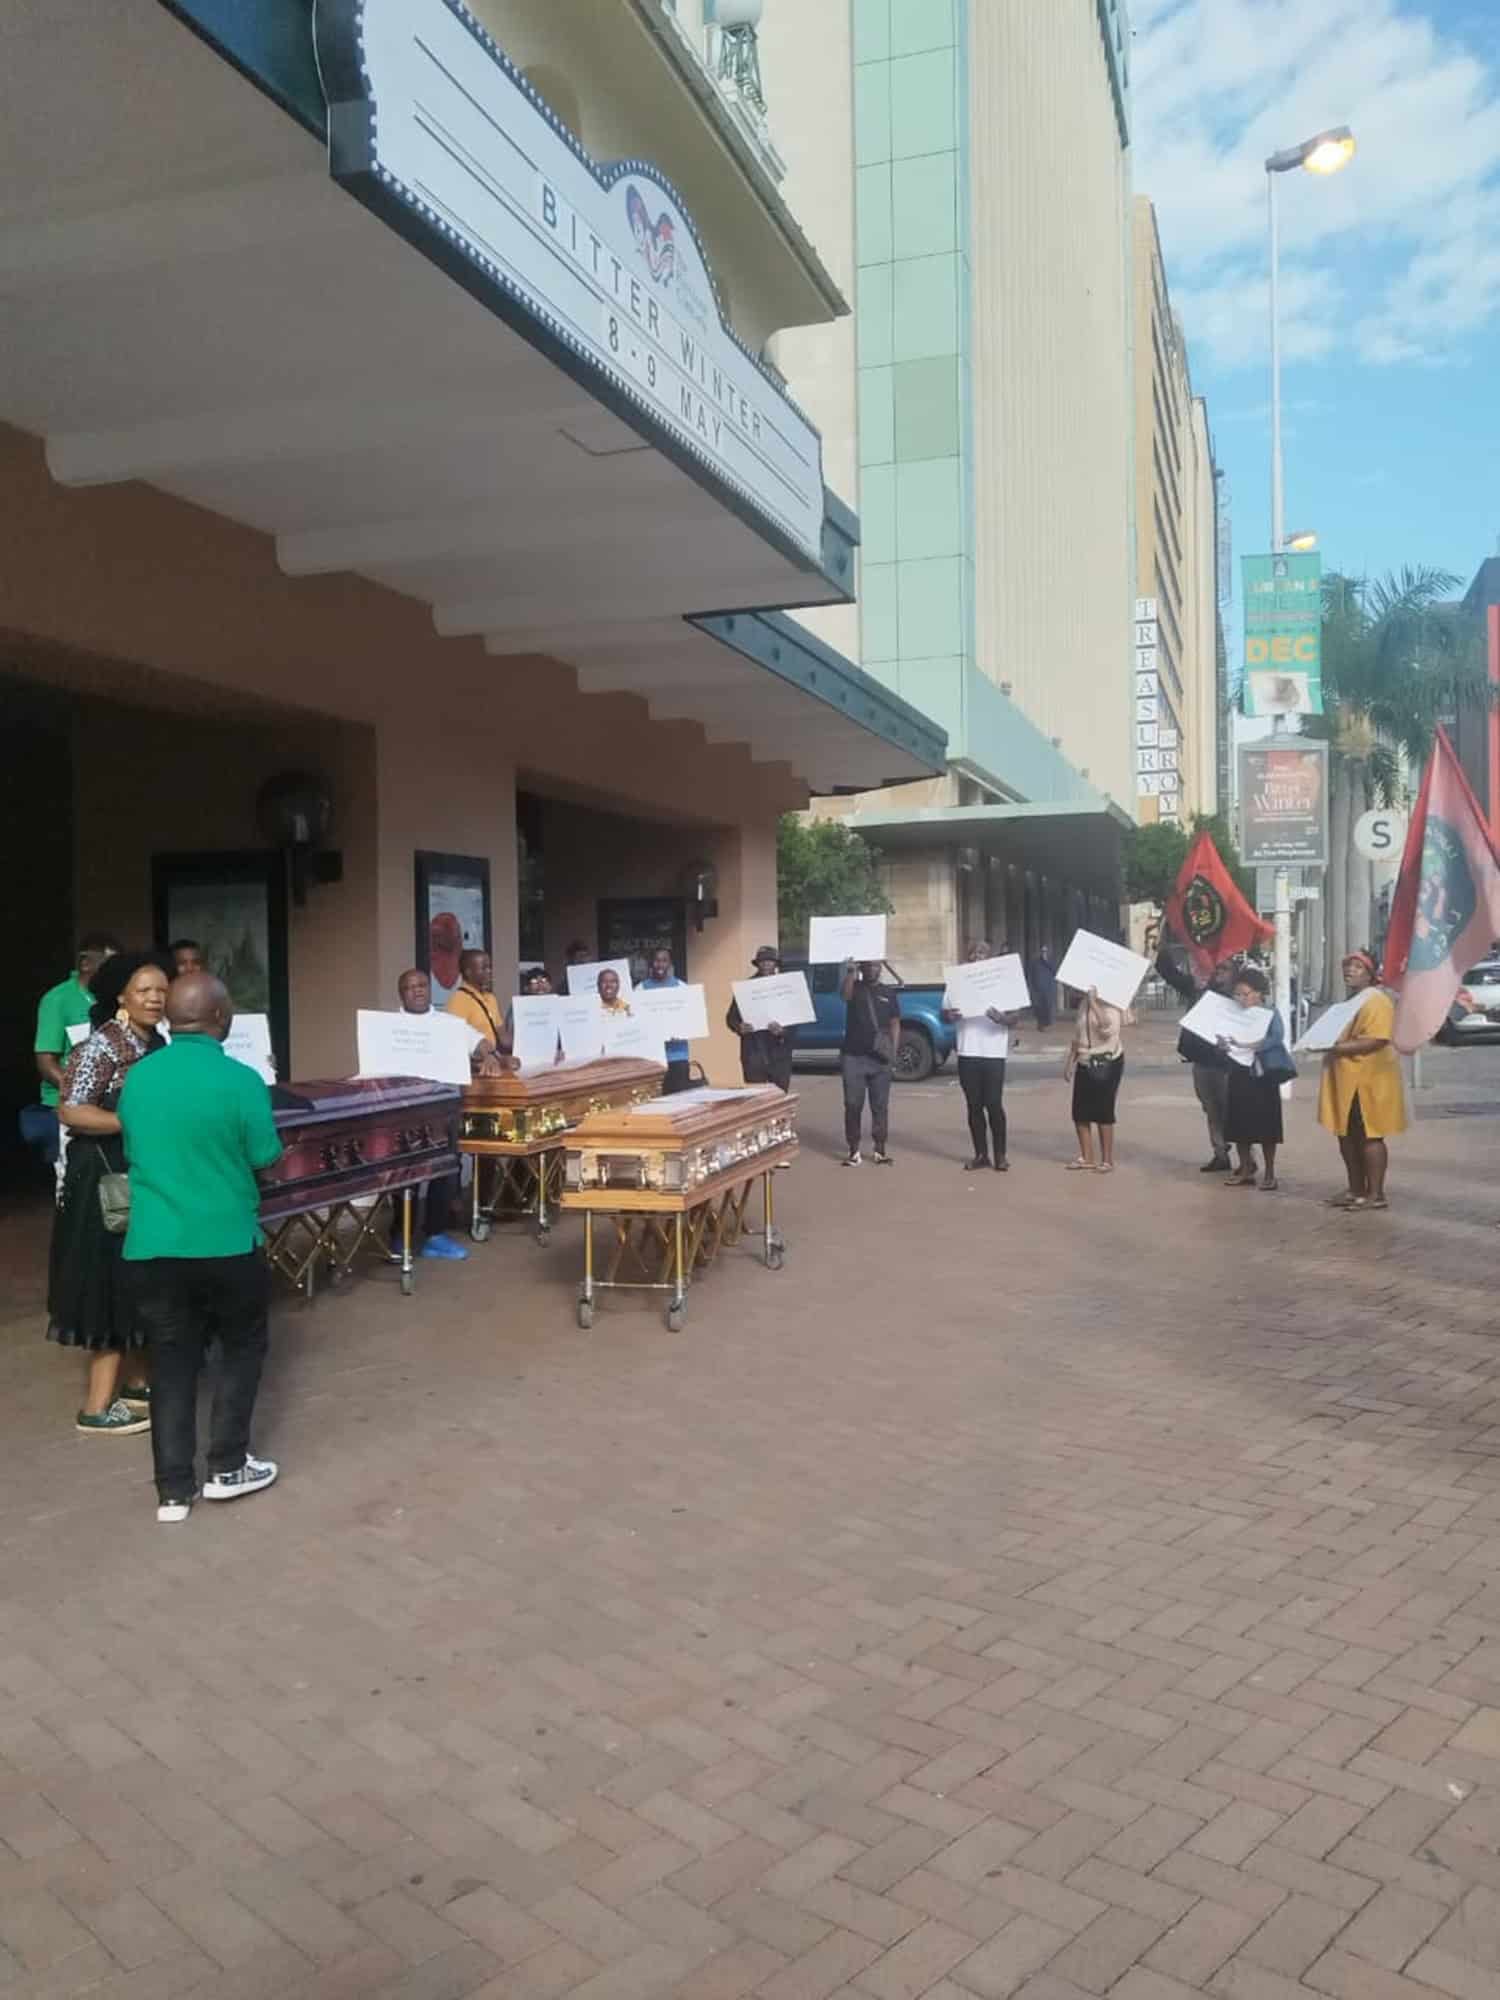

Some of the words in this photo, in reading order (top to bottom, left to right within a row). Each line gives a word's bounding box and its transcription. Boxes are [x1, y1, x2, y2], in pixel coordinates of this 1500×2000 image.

[542, 182, 660, 338] BITTER
[680, 331, 762, 439] WINTER
[608, 316, 619, 352] 8
[646, 356, 657, 388] 9
[680, 386, 722, 445] MAY
[1137, 599, 1157, 792] TREASURY
[1246, 636, 1317, 663] DEC
[1371, 820, 1392, 849] S
